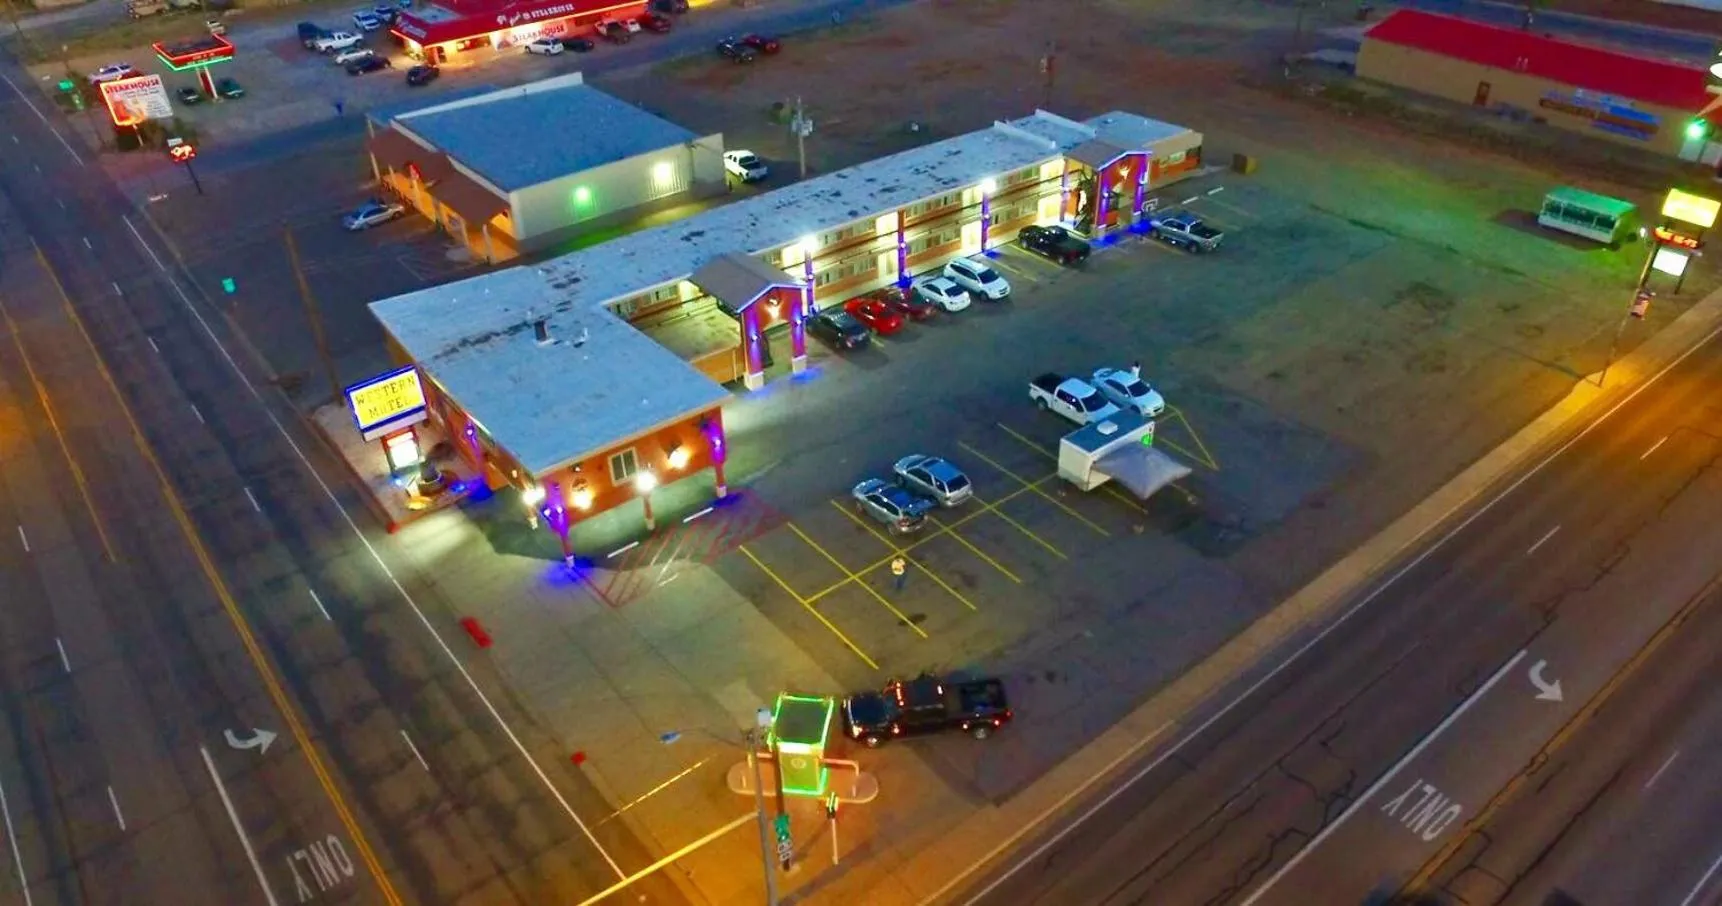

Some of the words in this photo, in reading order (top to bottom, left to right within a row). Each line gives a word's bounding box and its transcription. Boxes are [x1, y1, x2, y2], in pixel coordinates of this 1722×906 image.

[512, 24, 565, 43] STEAKHOUSE
[105, 79, 160, 94] STEAKHOUSE
[355, 375, 416, 406] WESTERN
[1379, 777, 1463, 842] ONLY
[286, 833, 354, 903] ONLY
